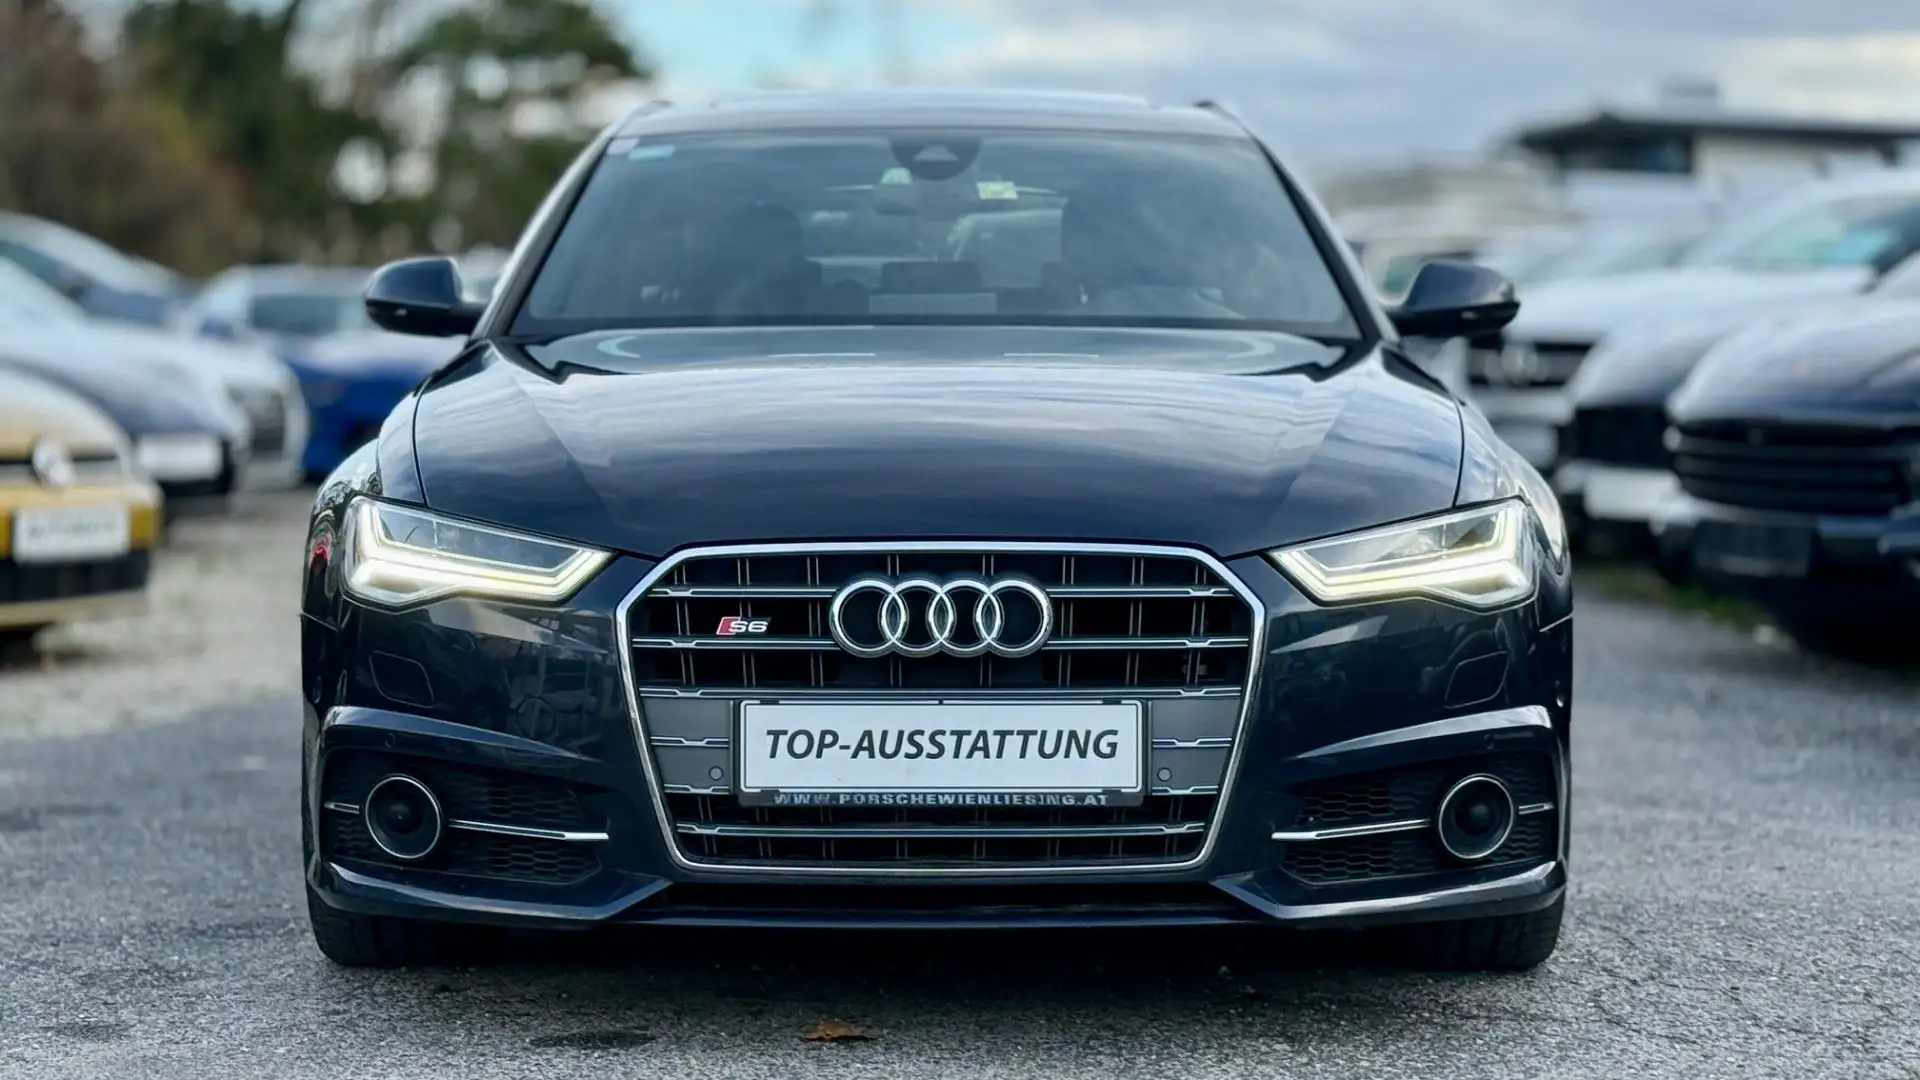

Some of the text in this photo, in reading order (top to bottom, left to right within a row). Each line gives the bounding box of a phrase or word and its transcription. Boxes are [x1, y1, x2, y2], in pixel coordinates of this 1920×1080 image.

[728, 620, 768, 633] S6
[766, 729, 1119, 760] TOP-AUSSTATTUNG
[774, 793, 1109, 806] WWW.PORSCHEWIENLIESING.AT
